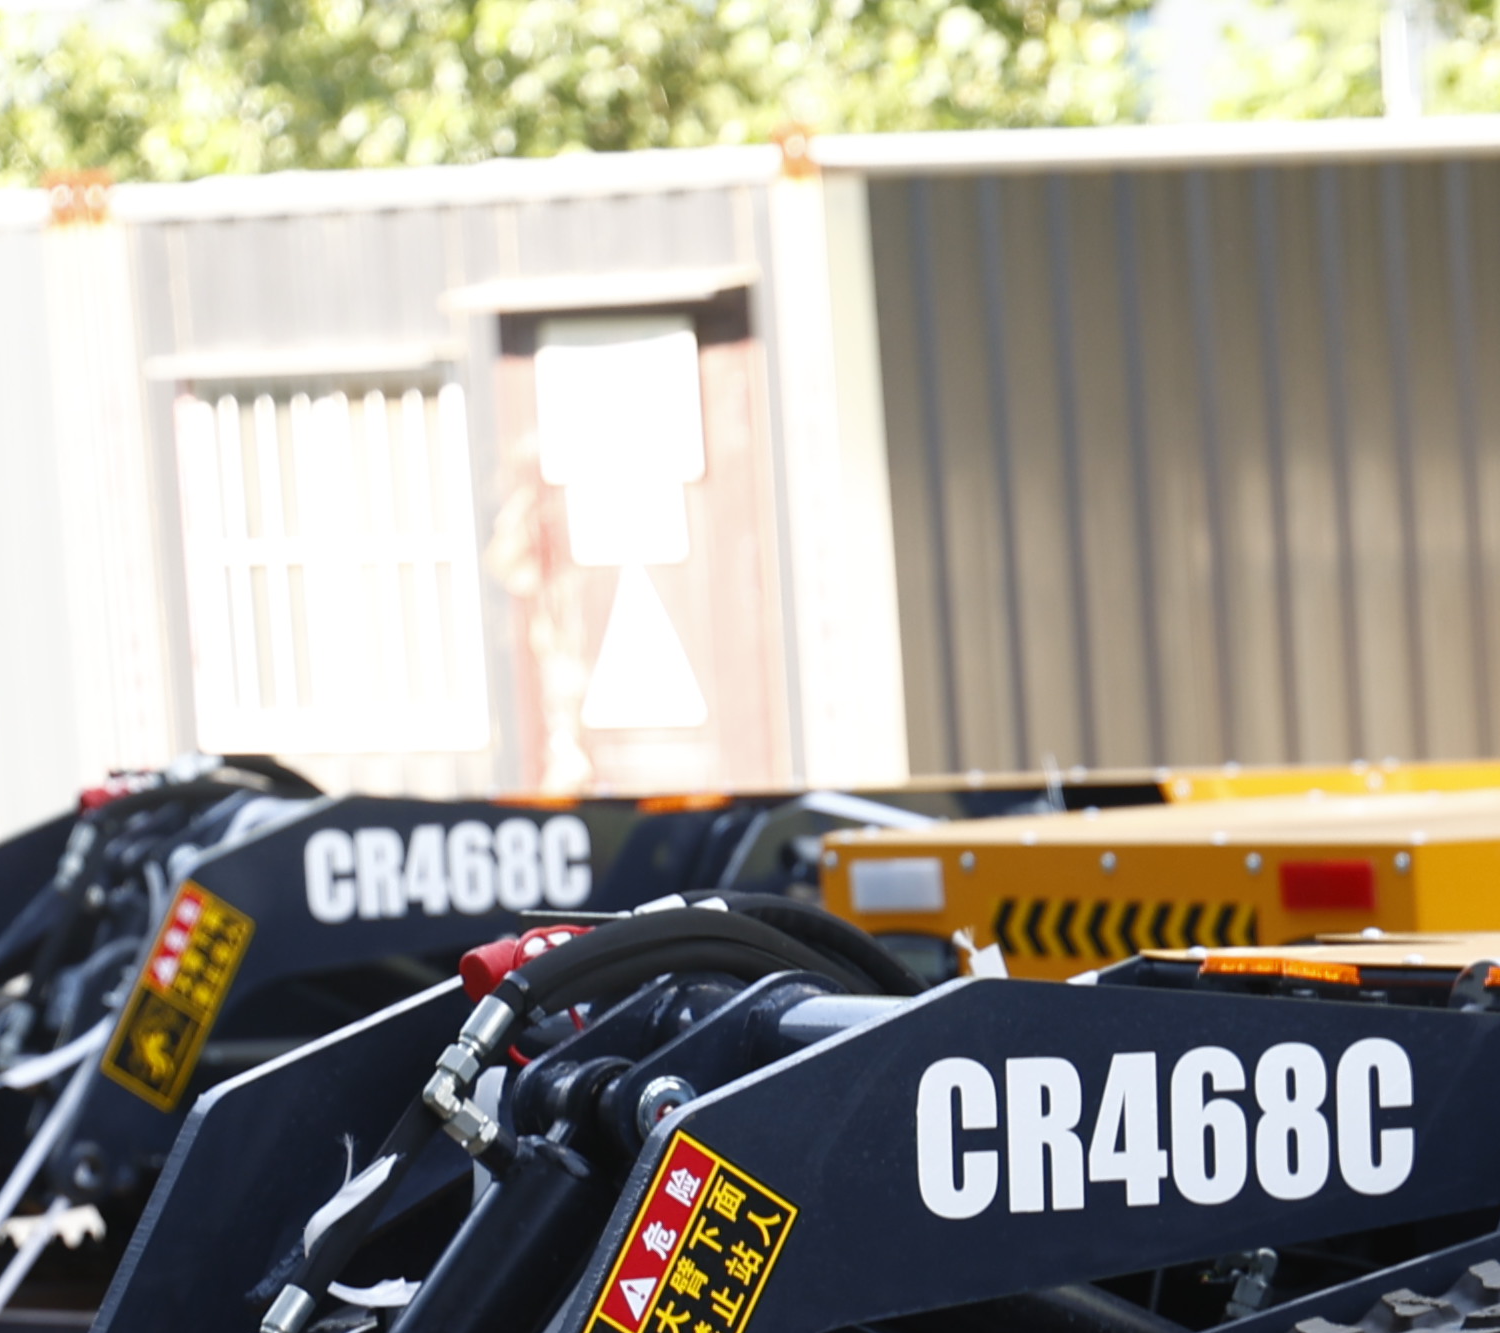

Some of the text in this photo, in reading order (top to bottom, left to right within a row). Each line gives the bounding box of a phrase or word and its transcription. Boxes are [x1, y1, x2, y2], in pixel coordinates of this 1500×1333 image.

[303, 814, 593, 924] CR468C
[916, 1037, 1415, 1220] CR468C
[642, 1167, 701, 1261] 危险
